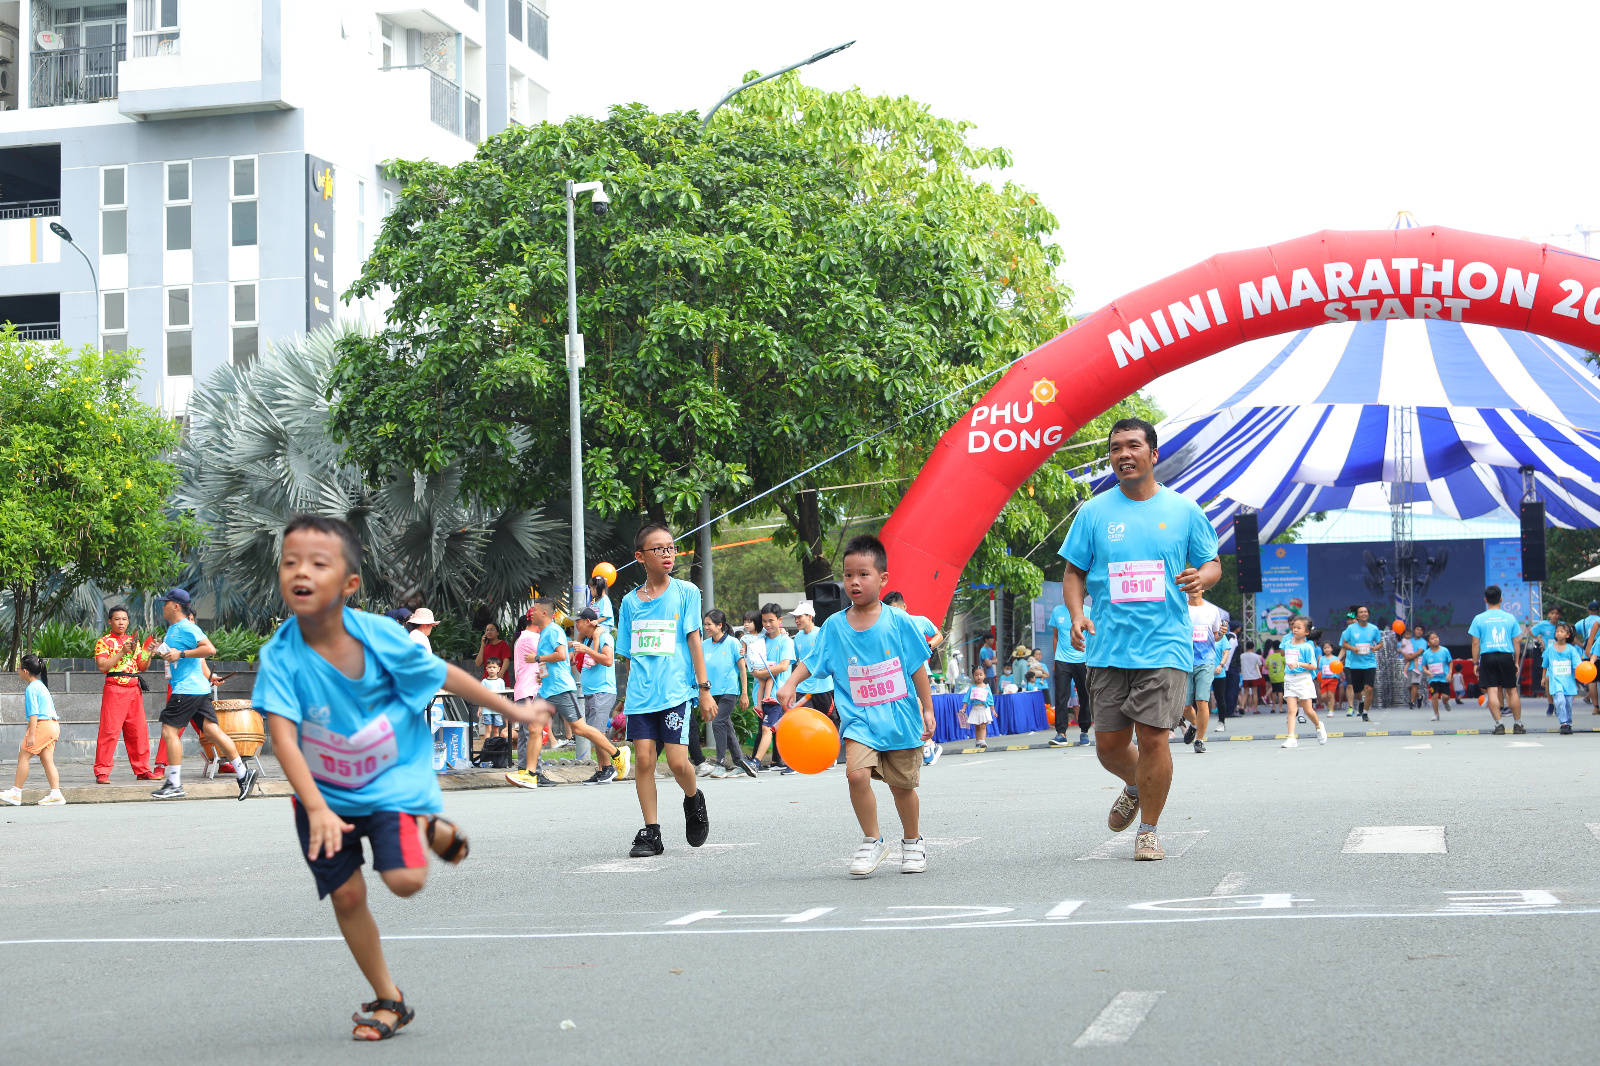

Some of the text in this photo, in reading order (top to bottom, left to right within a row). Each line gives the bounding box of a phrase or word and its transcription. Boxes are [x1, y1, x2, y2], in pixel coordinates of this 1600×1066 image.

[1107, 288, 1228, 369] MINI
[1239, 258, 1540, 320] MARATHON
[1324, 296, 1470, 324] START
[971, 400, 1033, 427] PHU
[968, 425, 1063, 453] DONG
[1108, 525, 1126, 534] GO
[1122, 579, 1153, 594] 0510
[638, 635, 661, 648] 0371
[860, 679, 895, 699] 0589
[450, 733, 459, 762] AQUAFINA
[322, 754, 377, 777] 0510
